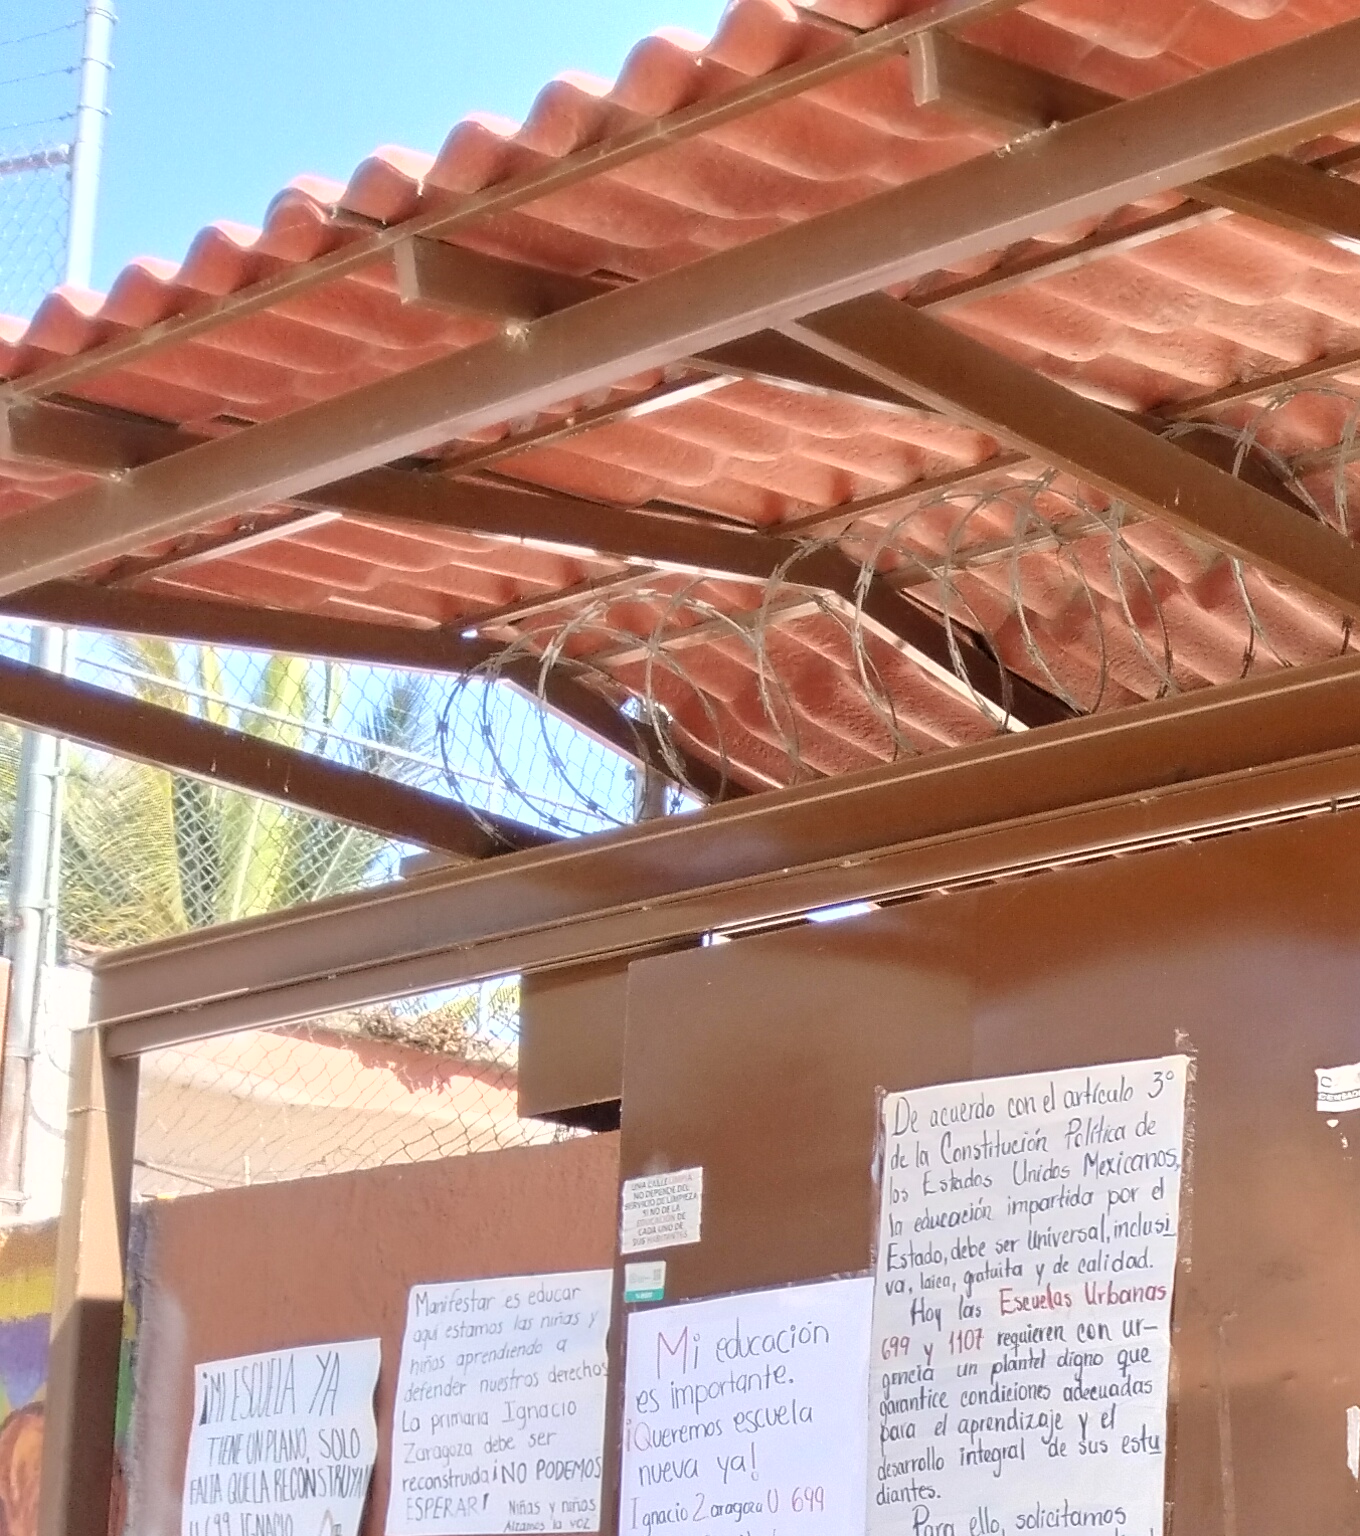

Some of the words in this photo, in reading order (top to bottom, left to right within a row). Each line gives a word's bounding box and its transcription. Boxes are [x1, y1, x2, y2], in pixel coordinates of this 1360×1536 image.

[892, 1096, 919, 1136] De
[930, 1093, 995, 1128] acuerdo
[1008, 1094, 1037, 1118] con
[1043, 1082, 1056, 1113] el
[1064, 1075, 1133, 1109] artículo
[891, 1144, 909, 1170] de
[916, 1141, 929, 1167] la
[1136, 1112, 1157, 1136] de
[890, 1177, 908, 1205] los
[922, 1169, 992, 1195] Estados
[1013, 1161, 1070, 1186] Unidos
[1083, 1148, 1181, 1178] Mexicanos,
[415, 1288, 495, 1317] Manifestar
[505, 1295, 520, 1309] es
[528, 1283, 581, 1303] educar
[910, 1298, 942, 1331] Hoy
[959, 1294, 982, 1320] las
[999, 1284, 1072, 1316] Escuelas
[1085, 1283, 1167, 1306] Urbanas
[657, 1326, 700, 1380] Mi
[716, 1317, 830, 1362] educación
[231, 1354, 296, 1422] ESCUELA
[309, 1351, 340, 1416] YA
[636, 1389, 660, 1414] es
[670, 1364, 794, 1414] importante.
[402, 1410, 420, 1432] La
[431, 1410, 489, 1435] primaria
[502, 1401, 577, 1430] Ignacio
[626, 1418, 722, 1452] ¡Queremos
[734, 1398, 813, 1434] escuela
[402, 1468, 489, 1492] reconstruida
[536, 1456, 601, 1481] PODEMOS
[638, 1458, 699, 1486] nueva
[717, 1442, 759, 1484] ya!
[405, 1493, 489, 1521] ESPERAR!
[792, 1486, 824, 1513] 699
[1016, 1499, 1126, 1529] solicitamos
